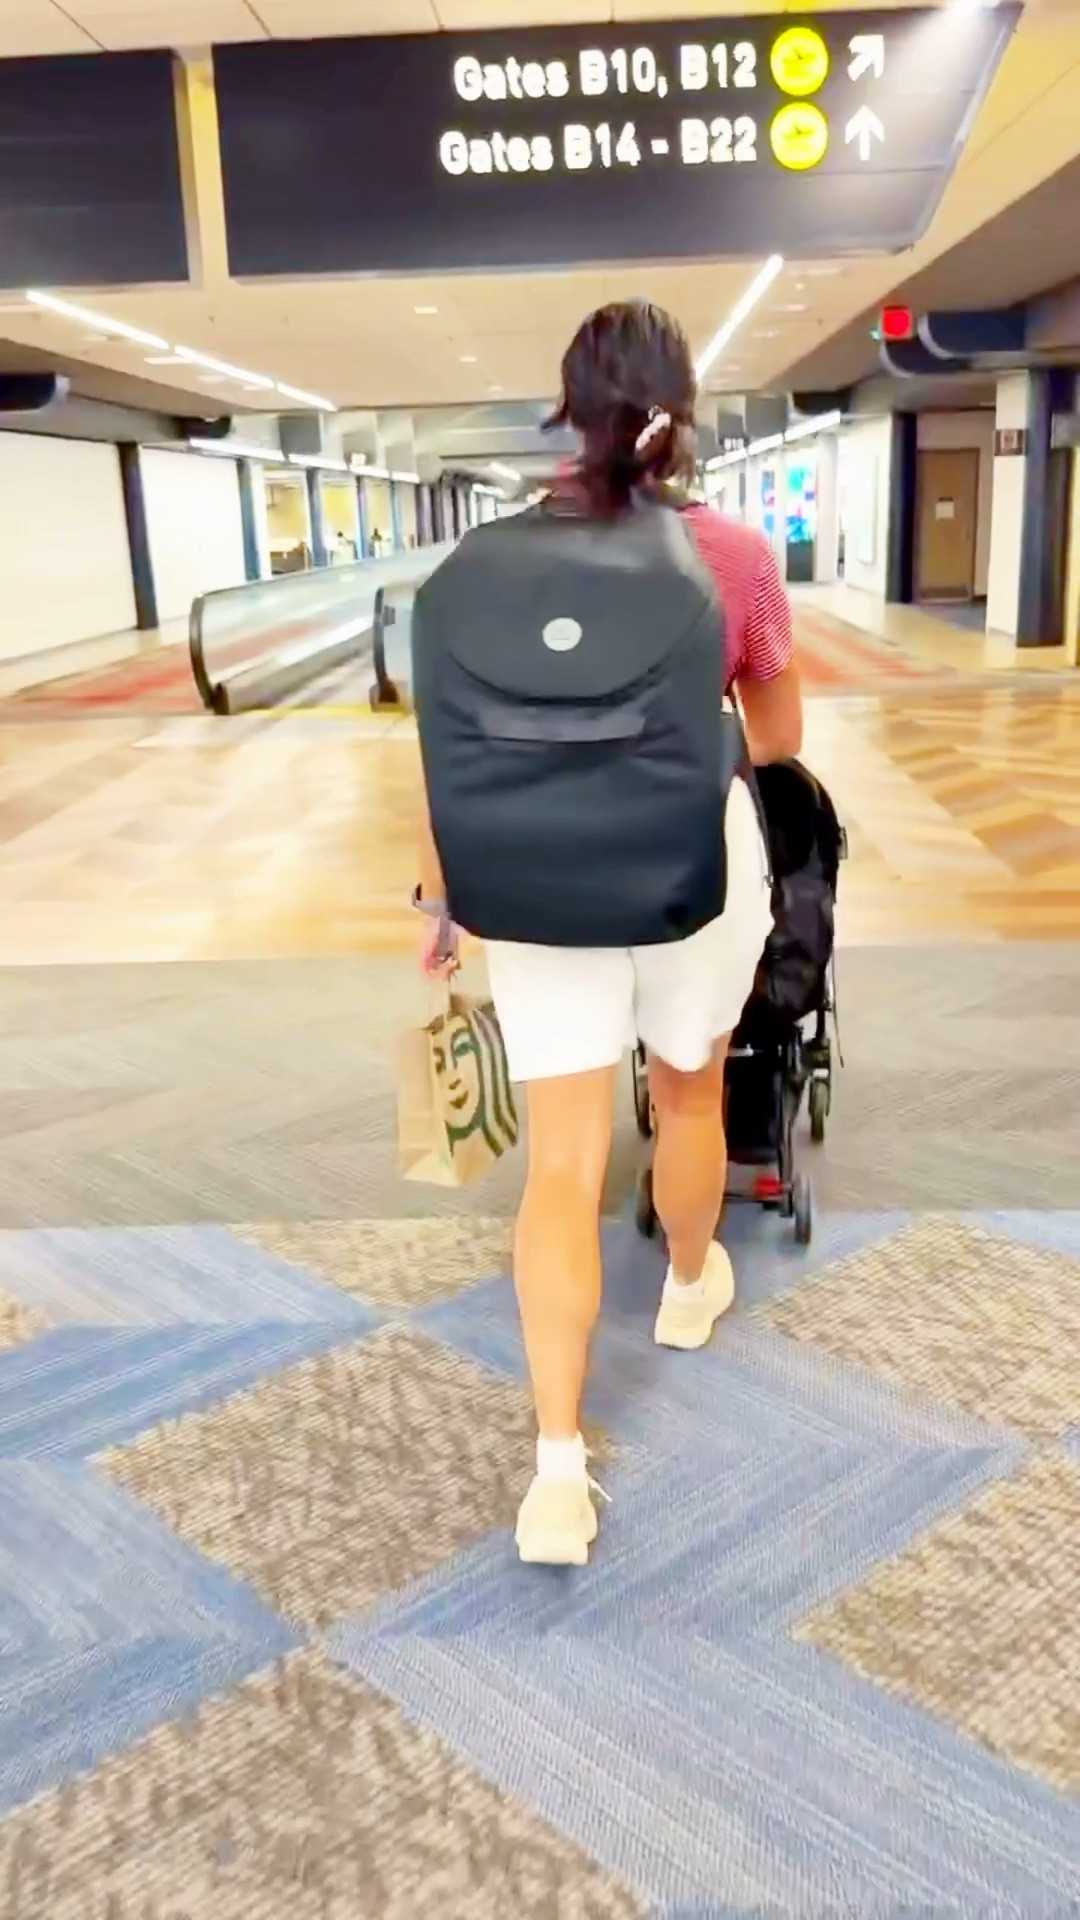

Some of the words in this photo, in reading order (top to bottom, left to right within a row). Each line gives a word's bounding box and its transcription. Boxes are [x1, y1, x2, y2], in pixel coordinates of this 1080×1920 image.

[453, 56, 570, 102] Gates
[579, 47, 668, 99] B10,
[680, 42, 757, 91] B12
[439, 130, 554, 176] Gates
[563, 121, 642, 170] B14
[651, 139, 669, 155] -
[680, 115, 758, 165] B22
